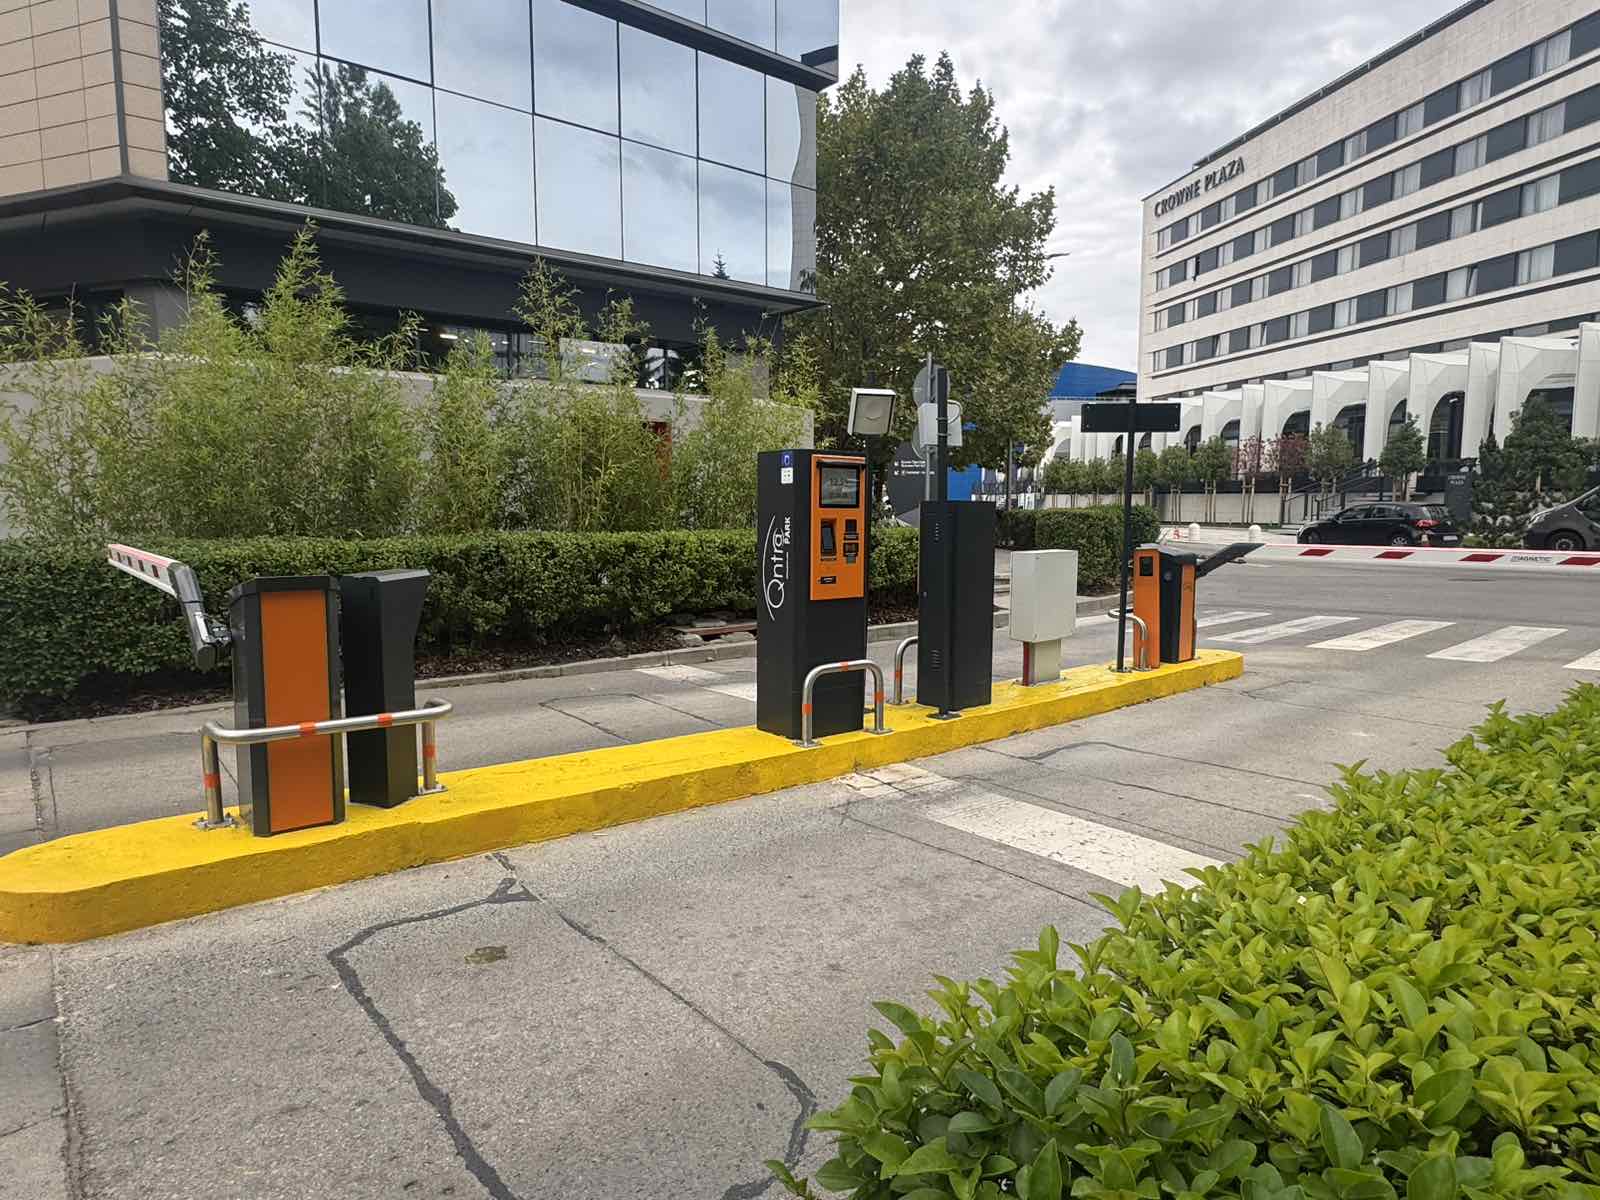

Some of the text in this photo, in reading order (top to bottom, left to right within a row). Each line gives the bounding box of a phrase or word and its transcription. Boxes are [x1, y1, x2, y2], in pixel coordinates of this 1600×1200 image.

[1154, 156, 1245, 218] CROWNE PLAZA
[767, 527, 785, 608] Qntra
